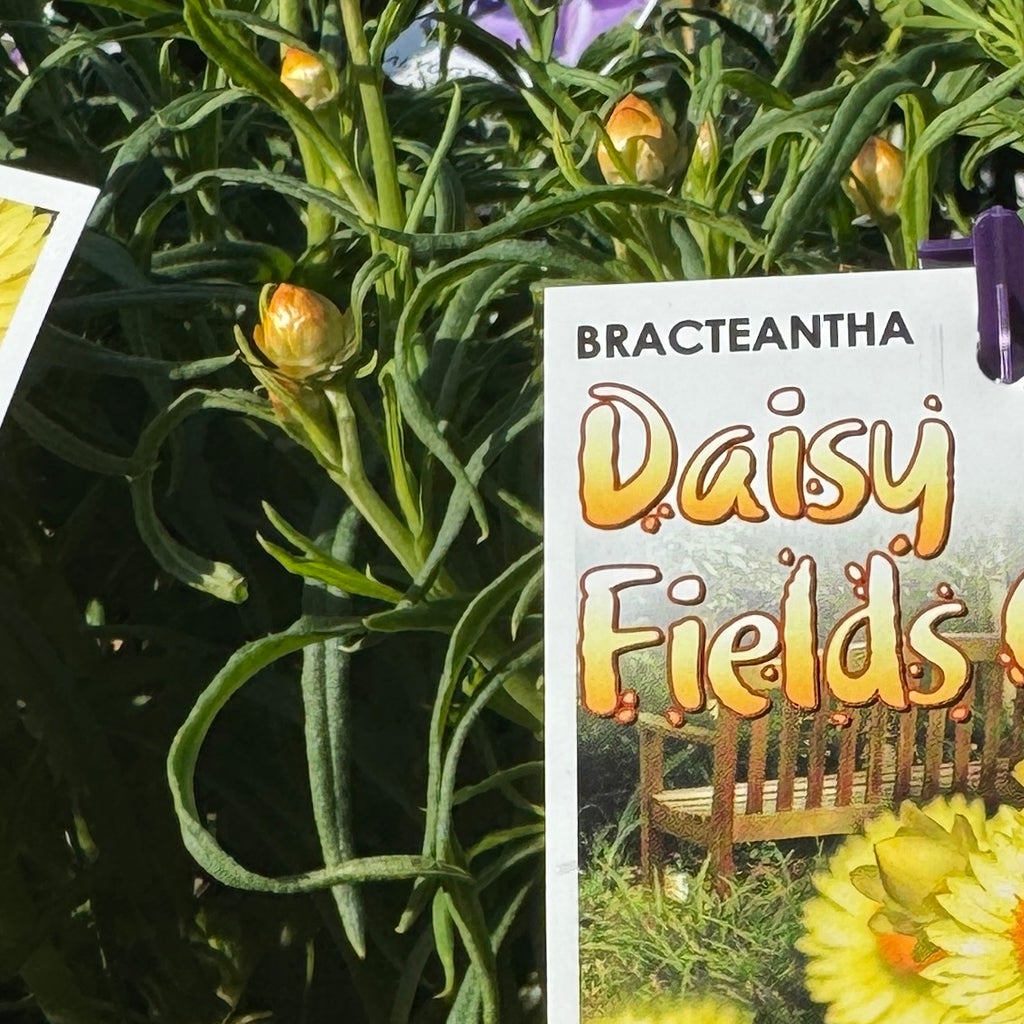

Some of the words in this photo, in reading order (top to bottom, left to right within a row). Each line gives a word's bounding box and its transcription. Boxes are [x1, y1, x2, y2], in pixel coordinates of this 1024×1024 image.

[577, 311, 914, 359] BRACTEANTHA
[579, 382, 955, 560] Daisy
[579, 548, 972, 728] Fields
